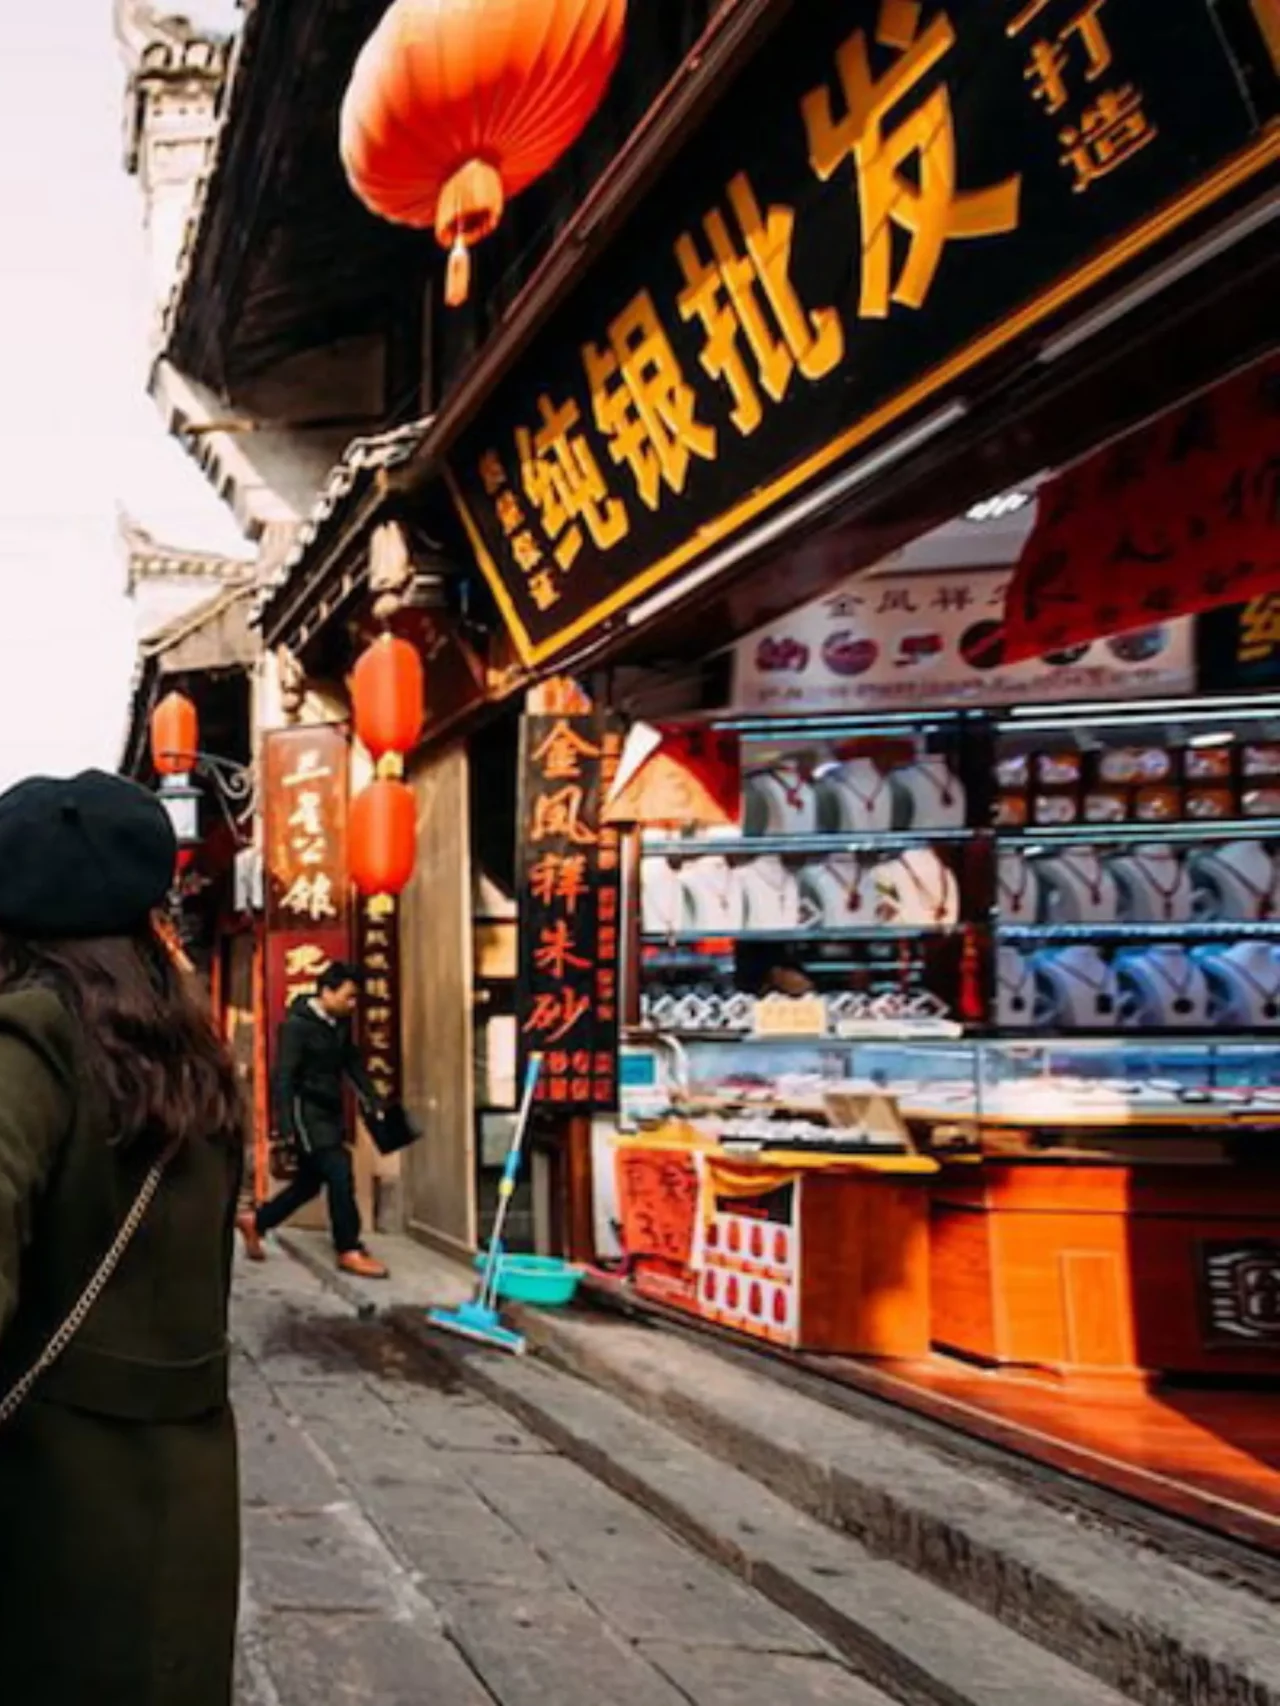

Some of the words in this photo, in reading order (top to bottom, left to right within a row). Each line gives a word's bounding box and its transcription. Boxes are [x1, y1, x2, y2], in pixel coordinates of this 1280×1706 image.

[516, 0, 1021, 571] 纯银批发
[1006, 0, 1158, 193] 打造
